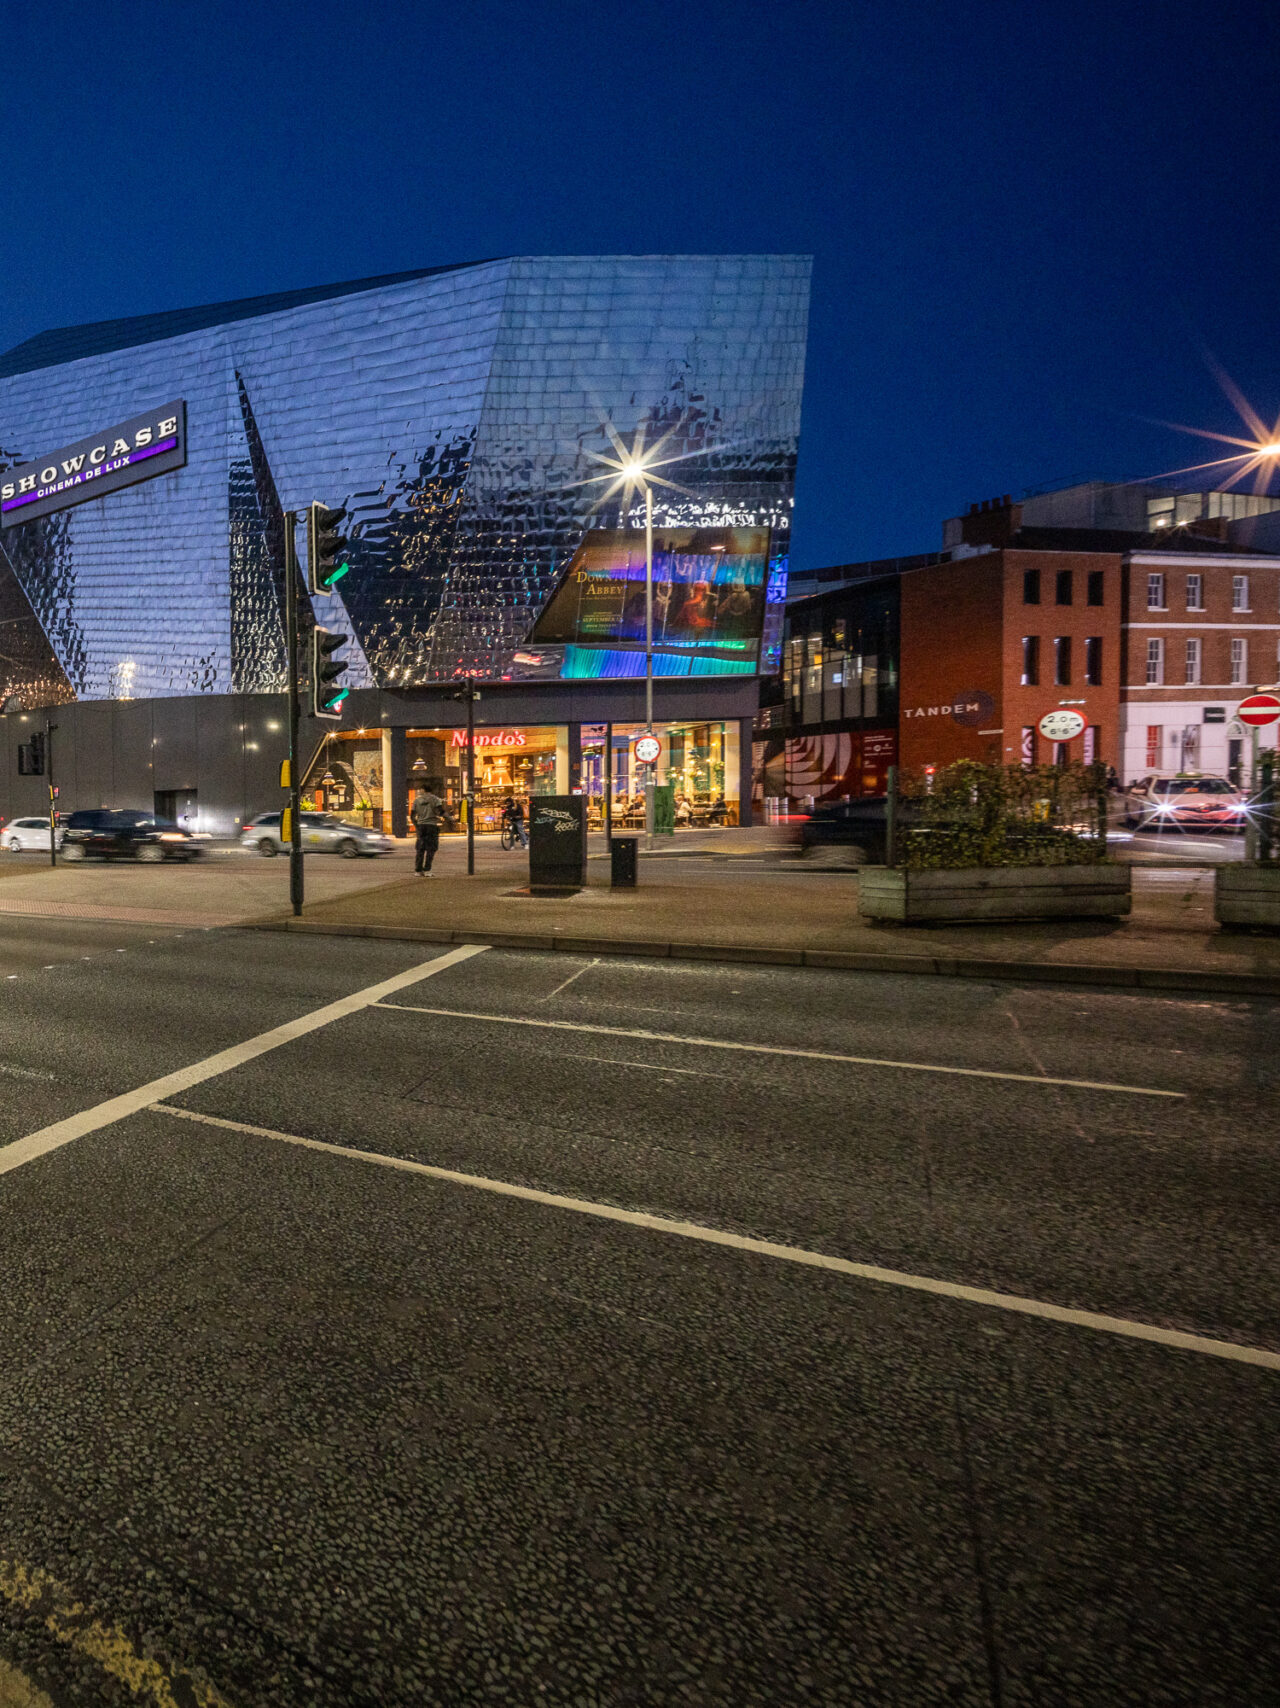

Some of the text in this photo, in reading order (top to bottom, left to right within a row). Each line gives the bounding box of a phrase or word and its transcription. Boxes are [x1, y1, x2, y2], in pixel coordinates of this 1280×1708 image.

[1, 416, 177, 500] SHOWCASE
[36, 456, 131, 498] CINEMA DE LUX
[585, 584, 624, 595] ABBEY
[904, 702, 979, 718] TANDEM
[451, 730, 526, 747] Nando's
